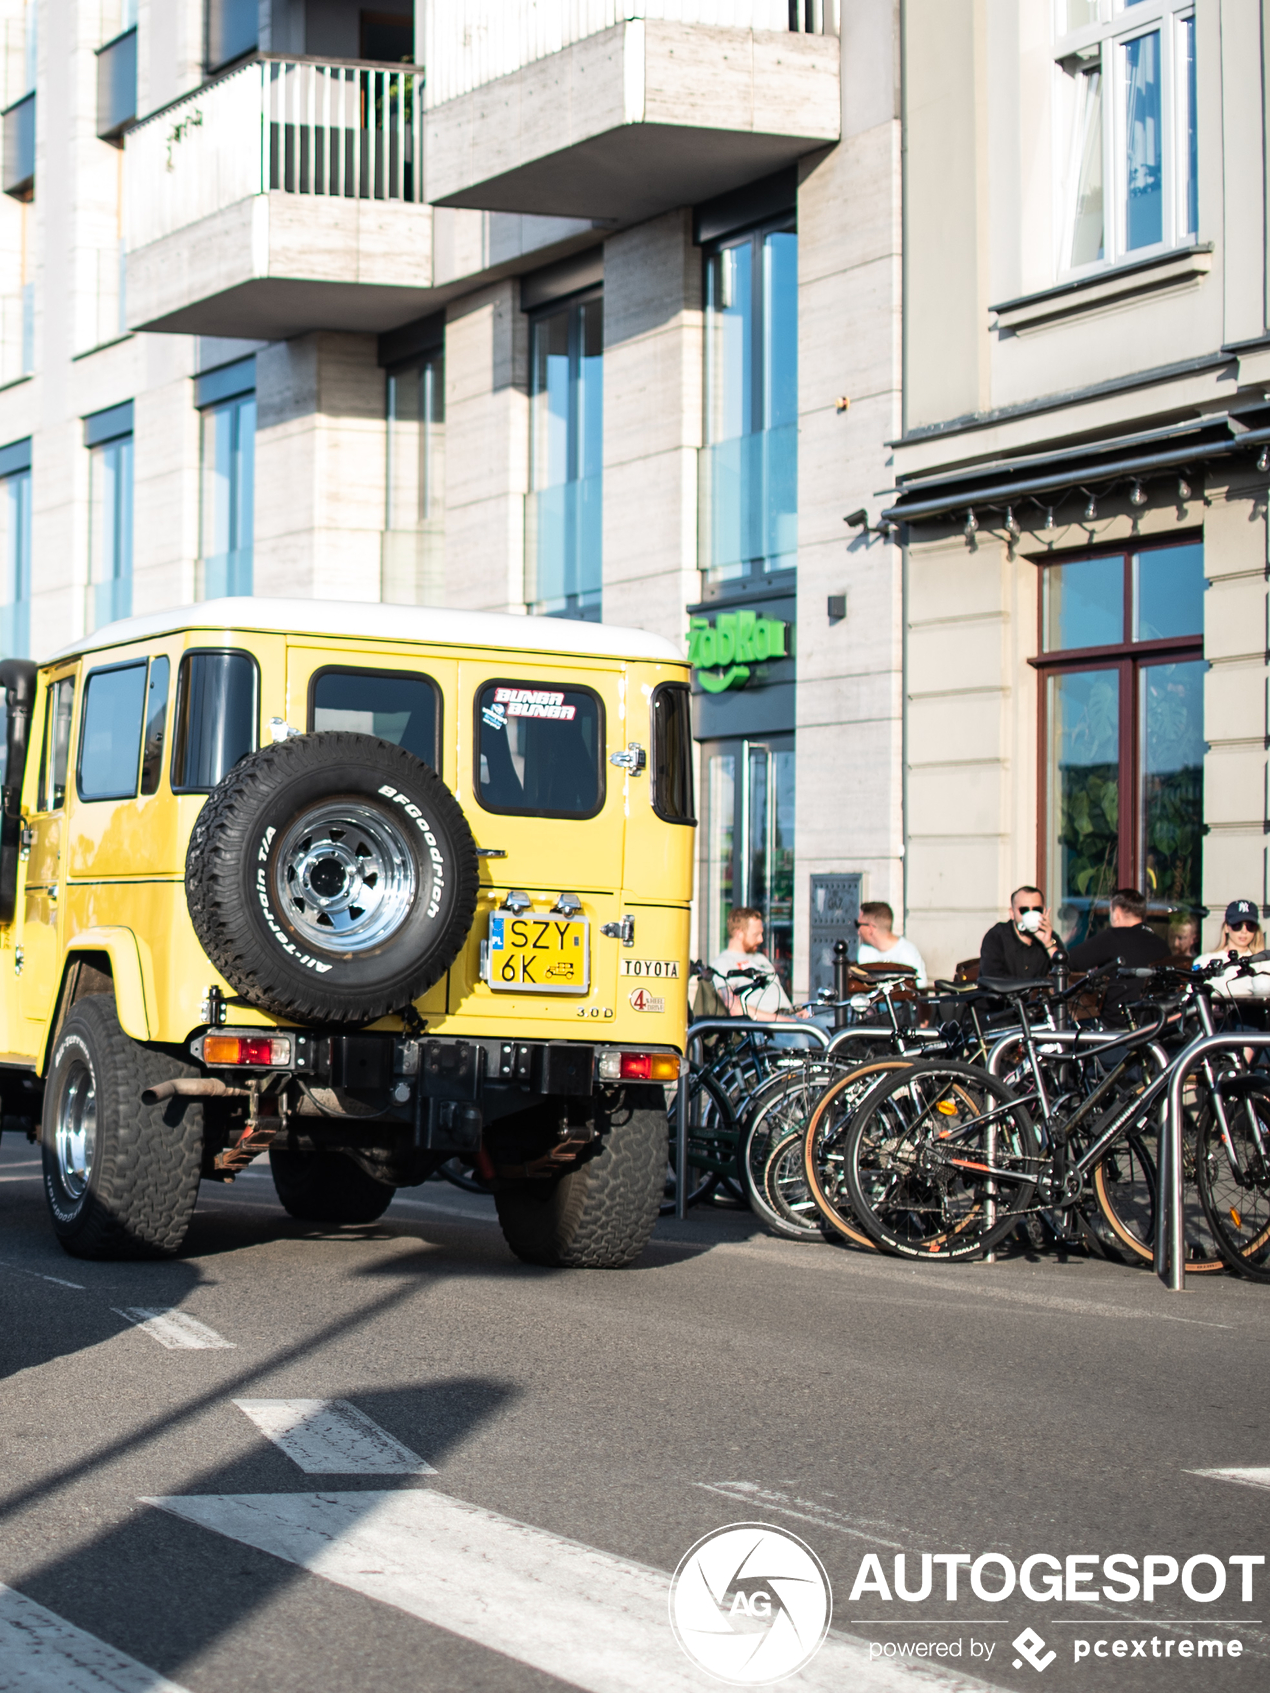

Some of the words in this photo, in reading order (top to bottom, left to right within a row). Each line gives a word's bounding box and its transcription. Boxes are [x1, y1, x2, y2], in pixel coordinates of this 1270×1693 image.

[492, 936, 504, 946] PL
[511, 920, 570, 950] SZY
[501, 954, 537, 984] 6K
[625, 961, 677, 977] TOYOTA
[633, 990, 647, 1010] 4
